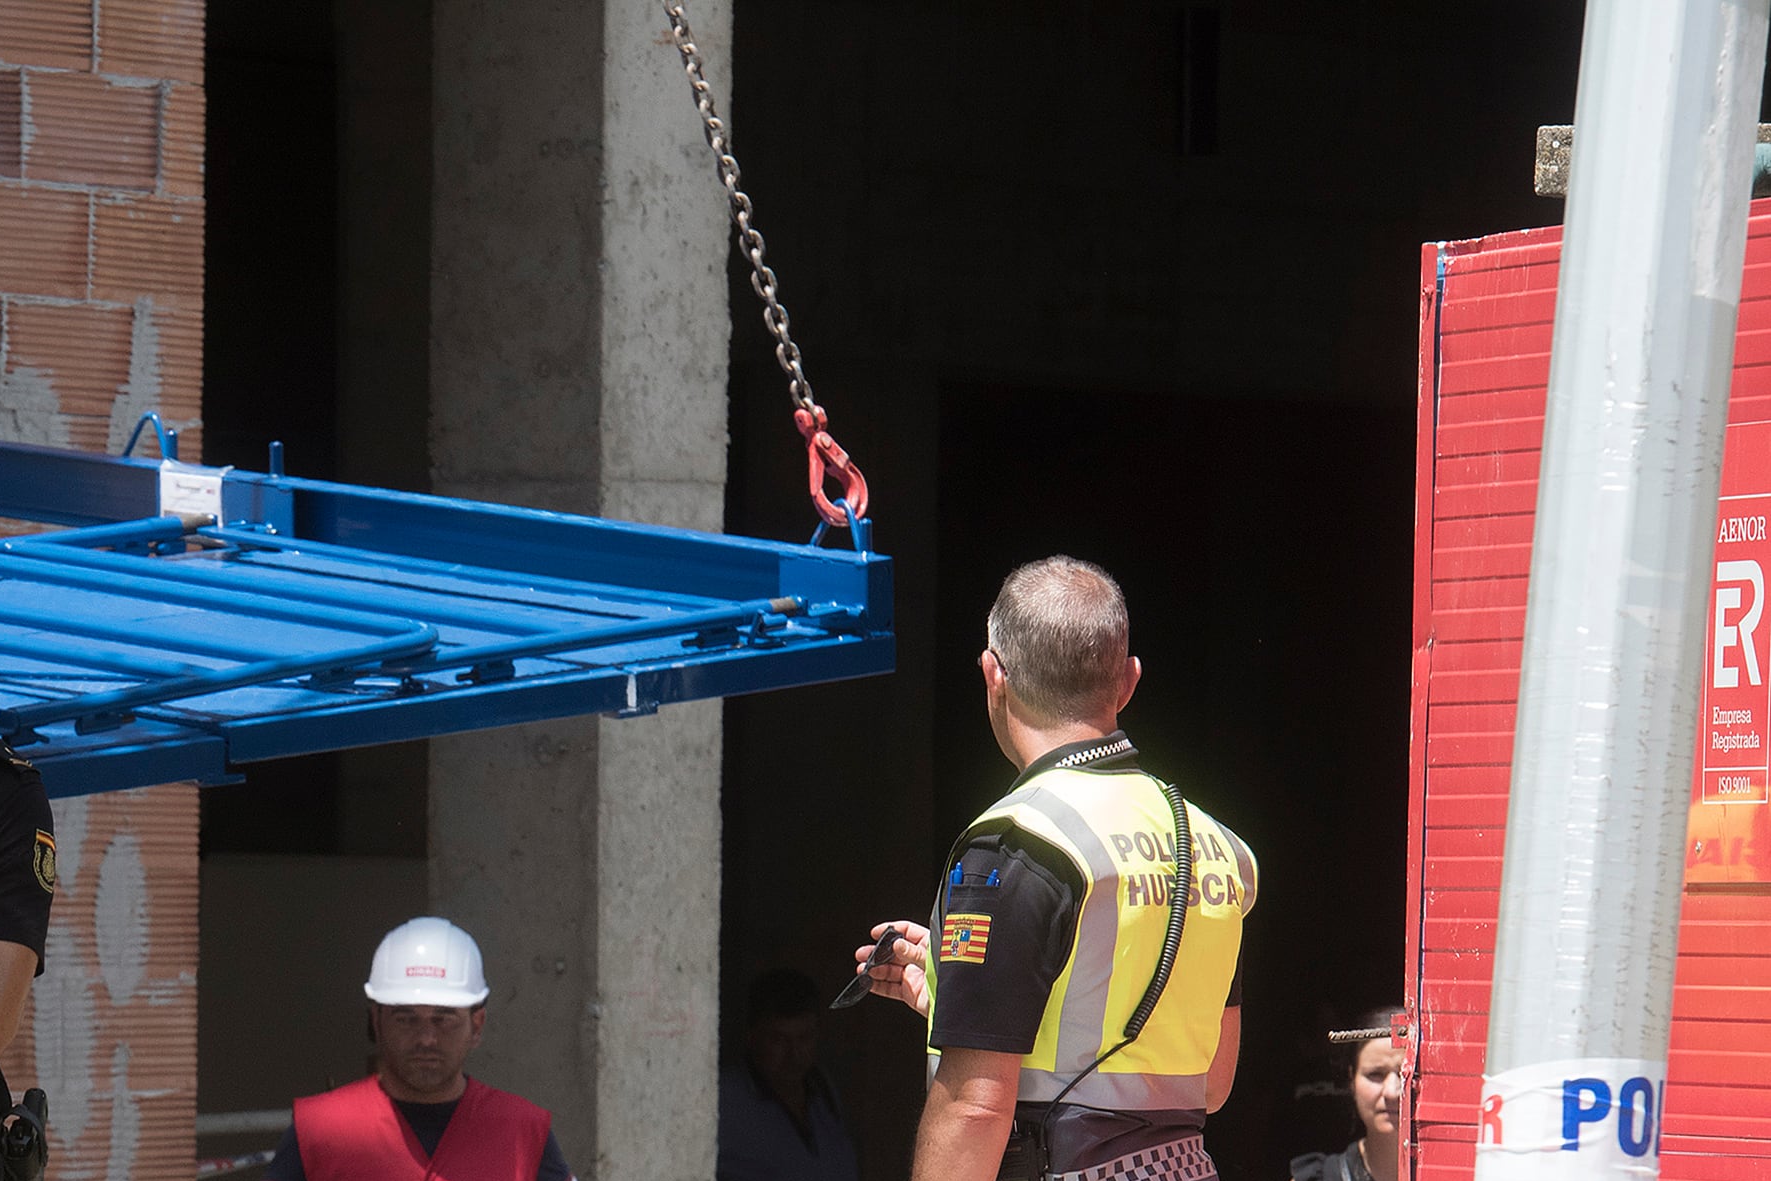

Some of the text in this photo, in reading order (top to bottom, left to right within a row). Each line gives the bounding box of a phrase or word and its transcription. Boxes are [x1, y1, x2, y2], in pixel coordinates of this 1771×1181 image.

[1717, 516, 1767, 544] AENOR
[1712, 706, 1752, 728] Empresa
[1711, 731, 1761, 754] Registrada
[1718, 776, 1752, 795] ISO 9001
[1561, 1077, 1664, 1158] PO
